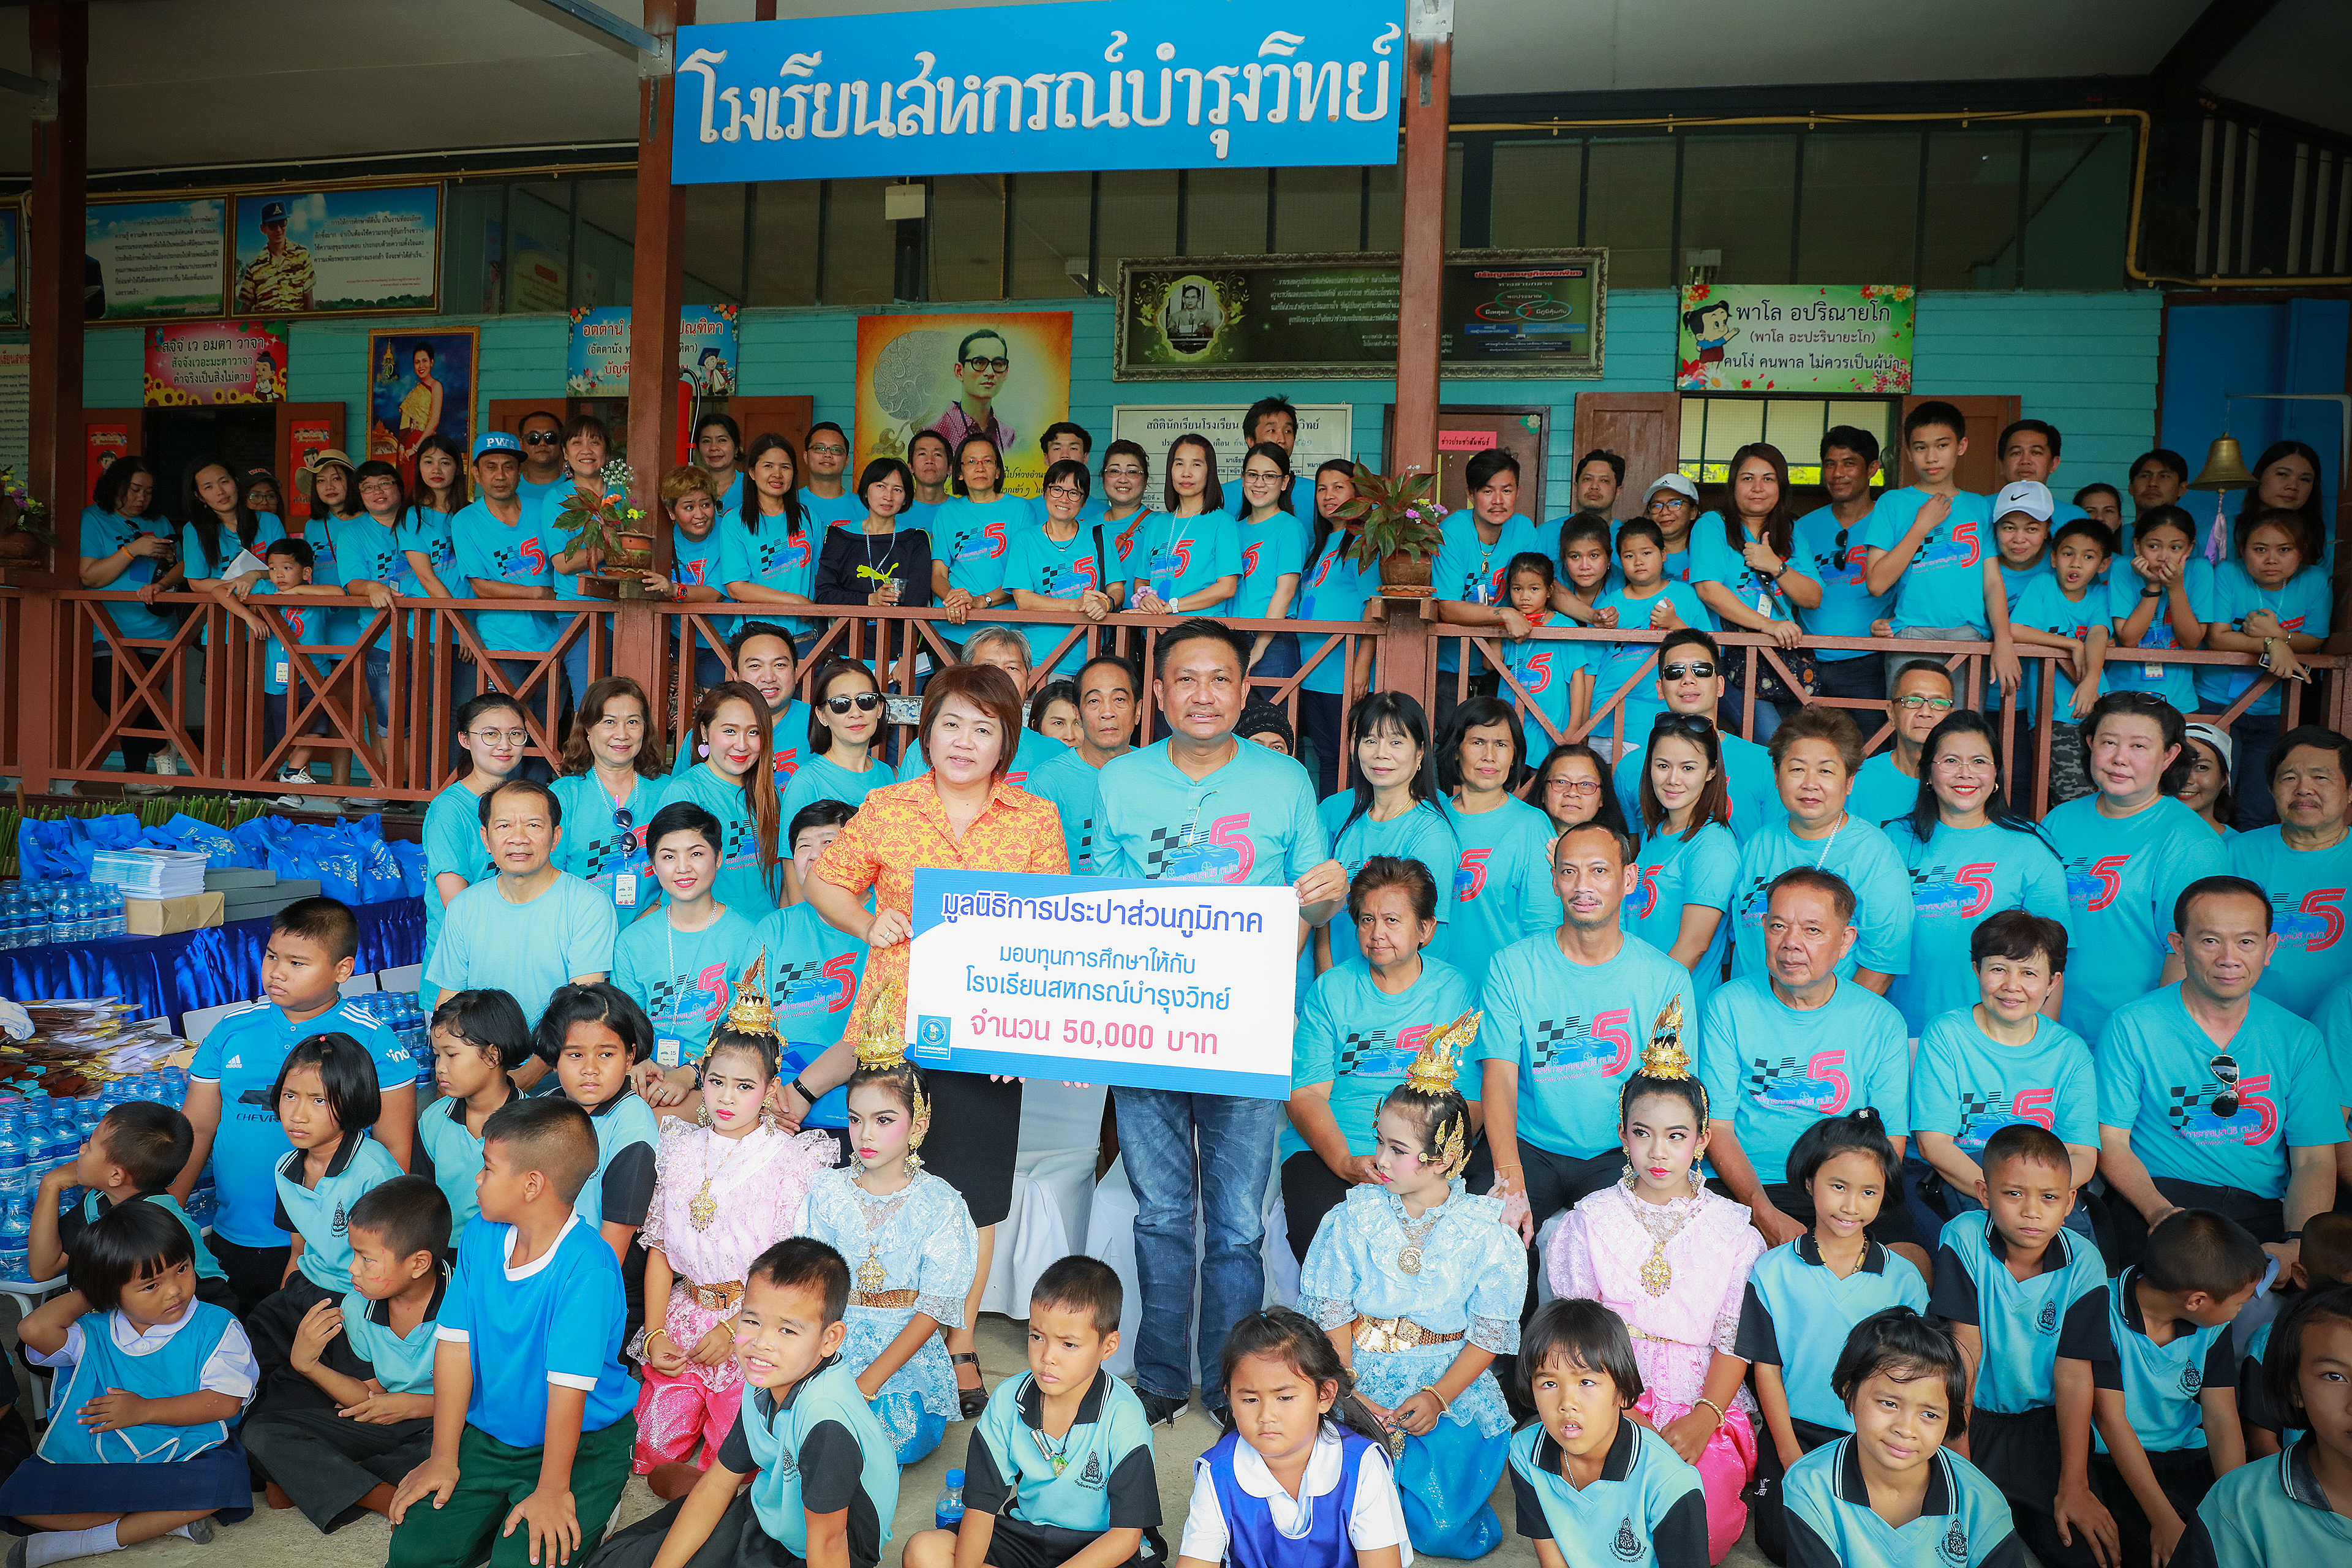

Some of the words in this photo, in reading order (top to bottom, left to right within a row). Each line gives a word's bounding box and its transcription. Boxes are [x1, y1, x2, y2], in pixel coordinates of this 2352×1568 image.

[678, 22, 1401, 159] โรงเรียนสหกรณ์บำรุงวิทย์
[1474, 269, 1583, 279] ปรัชญาเศรษฐกิจพอเพียง
[1736, 299, 1782, 322] พาโล
[1790, 299, 1890, 322] อปริณายโก
[187, 341, 198, 352] เว
[203, 338, 232, 351] อมตา
[236, 337, 265, 350] วาจา
[1750, 328, 1784, 344] (พาโล
[1789, 329, 1875, 344] อะปะรินายะโก)
[173, 369, 251, 385] คำจริงเป็นสิ่งไม่ตาย
[1724, 352, 1755, 368] คนโง่
[1760, 355, 1804, 369] คนพาล
[1809, 352, 1901, 375] ไม่ควรเป็นผู้นำ
[1146, 417, 1239, 431] สถิตินักเรียนโรงเรียน
[1441, 436, 1491, 446] ข่าวประชาสัมพันธ์
[1951, 522, 1980, 568] 5
[1526, 652, 1553, 694] 5
[1208, 812, 1255, 883] 5
[1458, 848, 1493, 902] 5
[1954, 862, 1997, 918] 5
[2087, 854, 2132, 911] 5
[942, 889, 1263, 938] มูลนิธิการประปาส่วนภูมิภาค
[2298, 888, 2347, 952] 5
[822, 951, 858, 1014] 5
[998, 944, 1196, 974] มอบทุนการศึกษาให้กับ
[965, 965, 1230, 1014] โรงเรียนสหกรณ์บำรุงวิทย์
[970, 1008, 1050, 1041] จำนวน
[1063, 1019, 1154, 1050] 50,000
[1168, 1028, 1219, 1055] บาท
[1590, 1008, 1632, 1078] 5
[1806, 1049, 1850, 1115] 5
